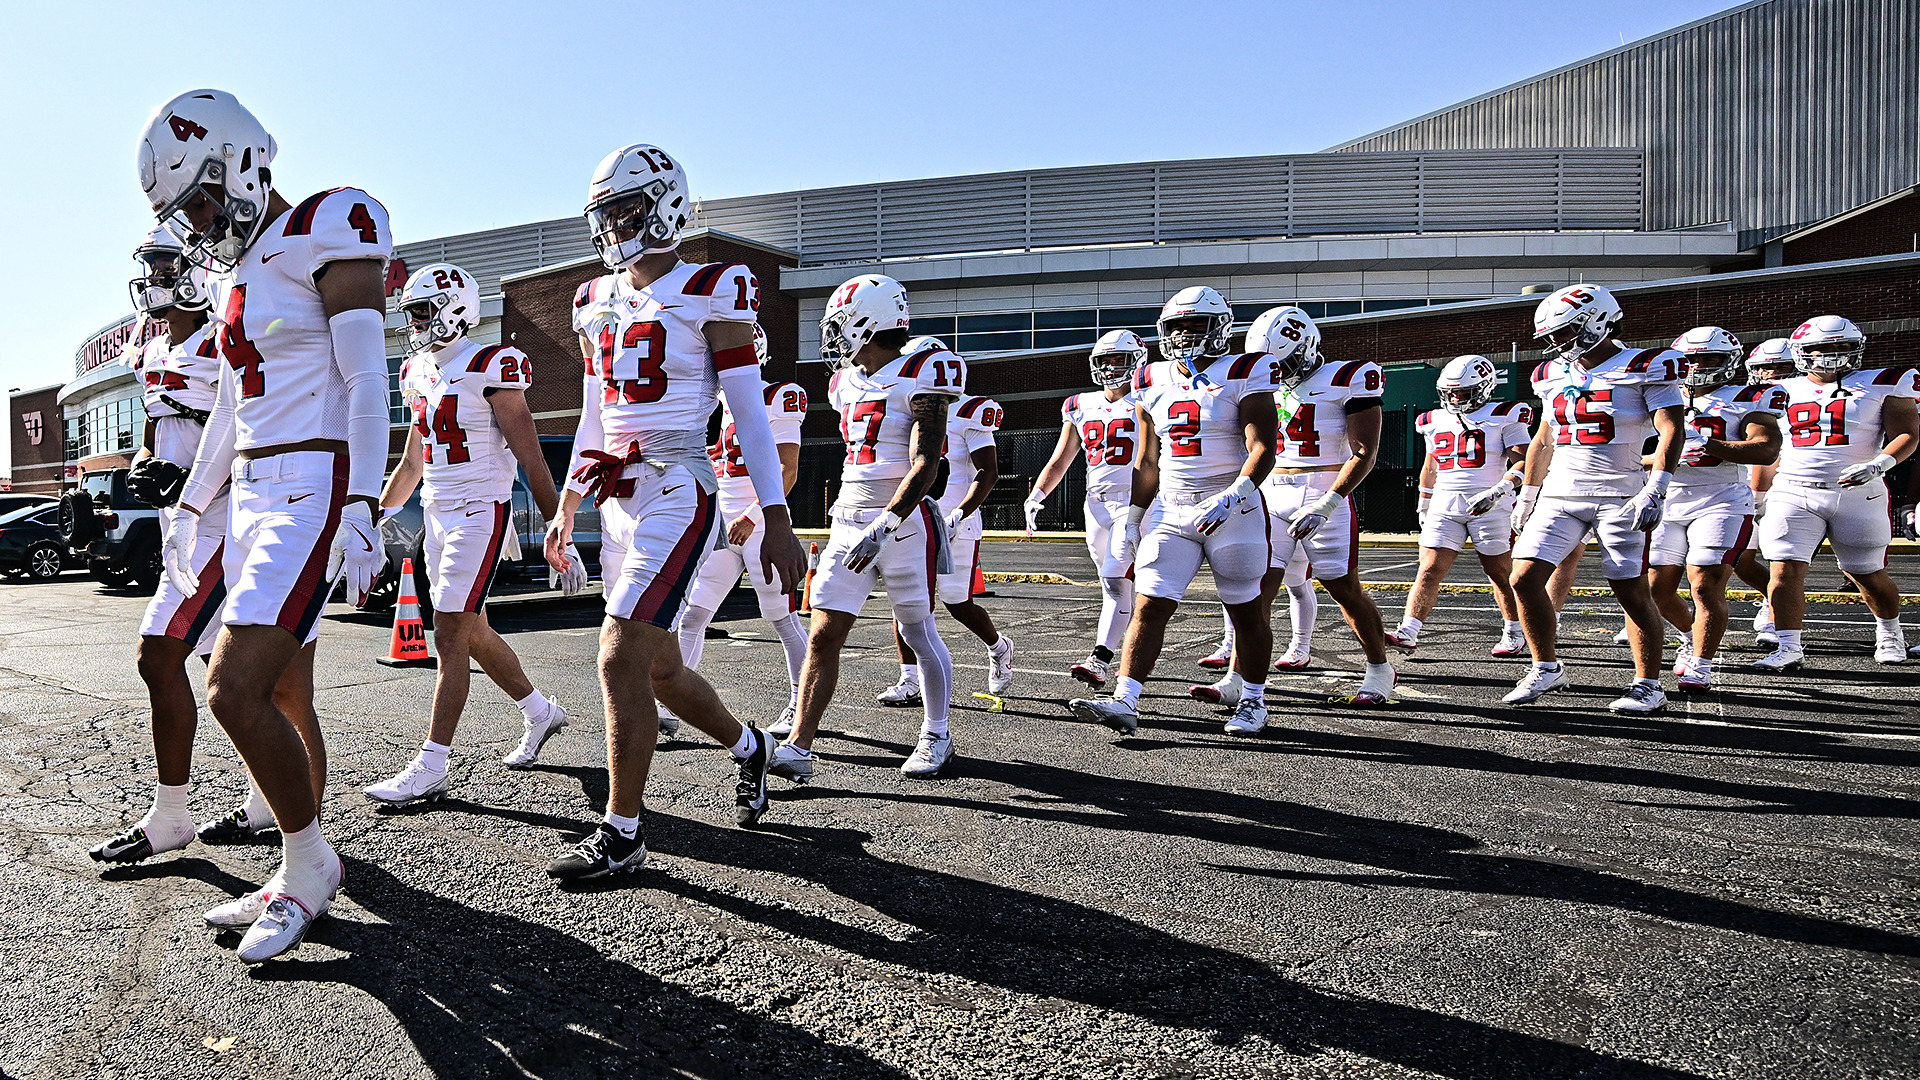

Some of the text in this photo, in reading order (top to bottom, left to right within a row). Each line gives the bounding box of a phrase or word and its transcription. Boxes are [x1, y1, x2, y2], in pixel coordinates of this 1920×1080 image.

[169, 115, 208, 142] 4
[637, 149, 674, 174] 13
[348, 203, 378, 244] 4
[433, 269, 464, 290] 24
[734, 276, 760, 311] 13
[837, 283, 859, 308] 17
[1561, 289, 1594, 310] 15
[220, 283, 265, 399] 4
[1280, 318, 1306, 341] 84
[500, 356, 531, 383] 24
[600, 321, 668, 406] 13
[933, 361, 962, 387] 17
[1474, 361, 1493, 378] 20
[1662, 358, 1690, 381] 15
[1168, 400, 1202, 457] 2
[1553, 389, 1615, 445] 15
[1787, 399, 1849, 447] 81
[1083, 418, 1135, 466] 86
[1432, 429, 1486, 470] 20
